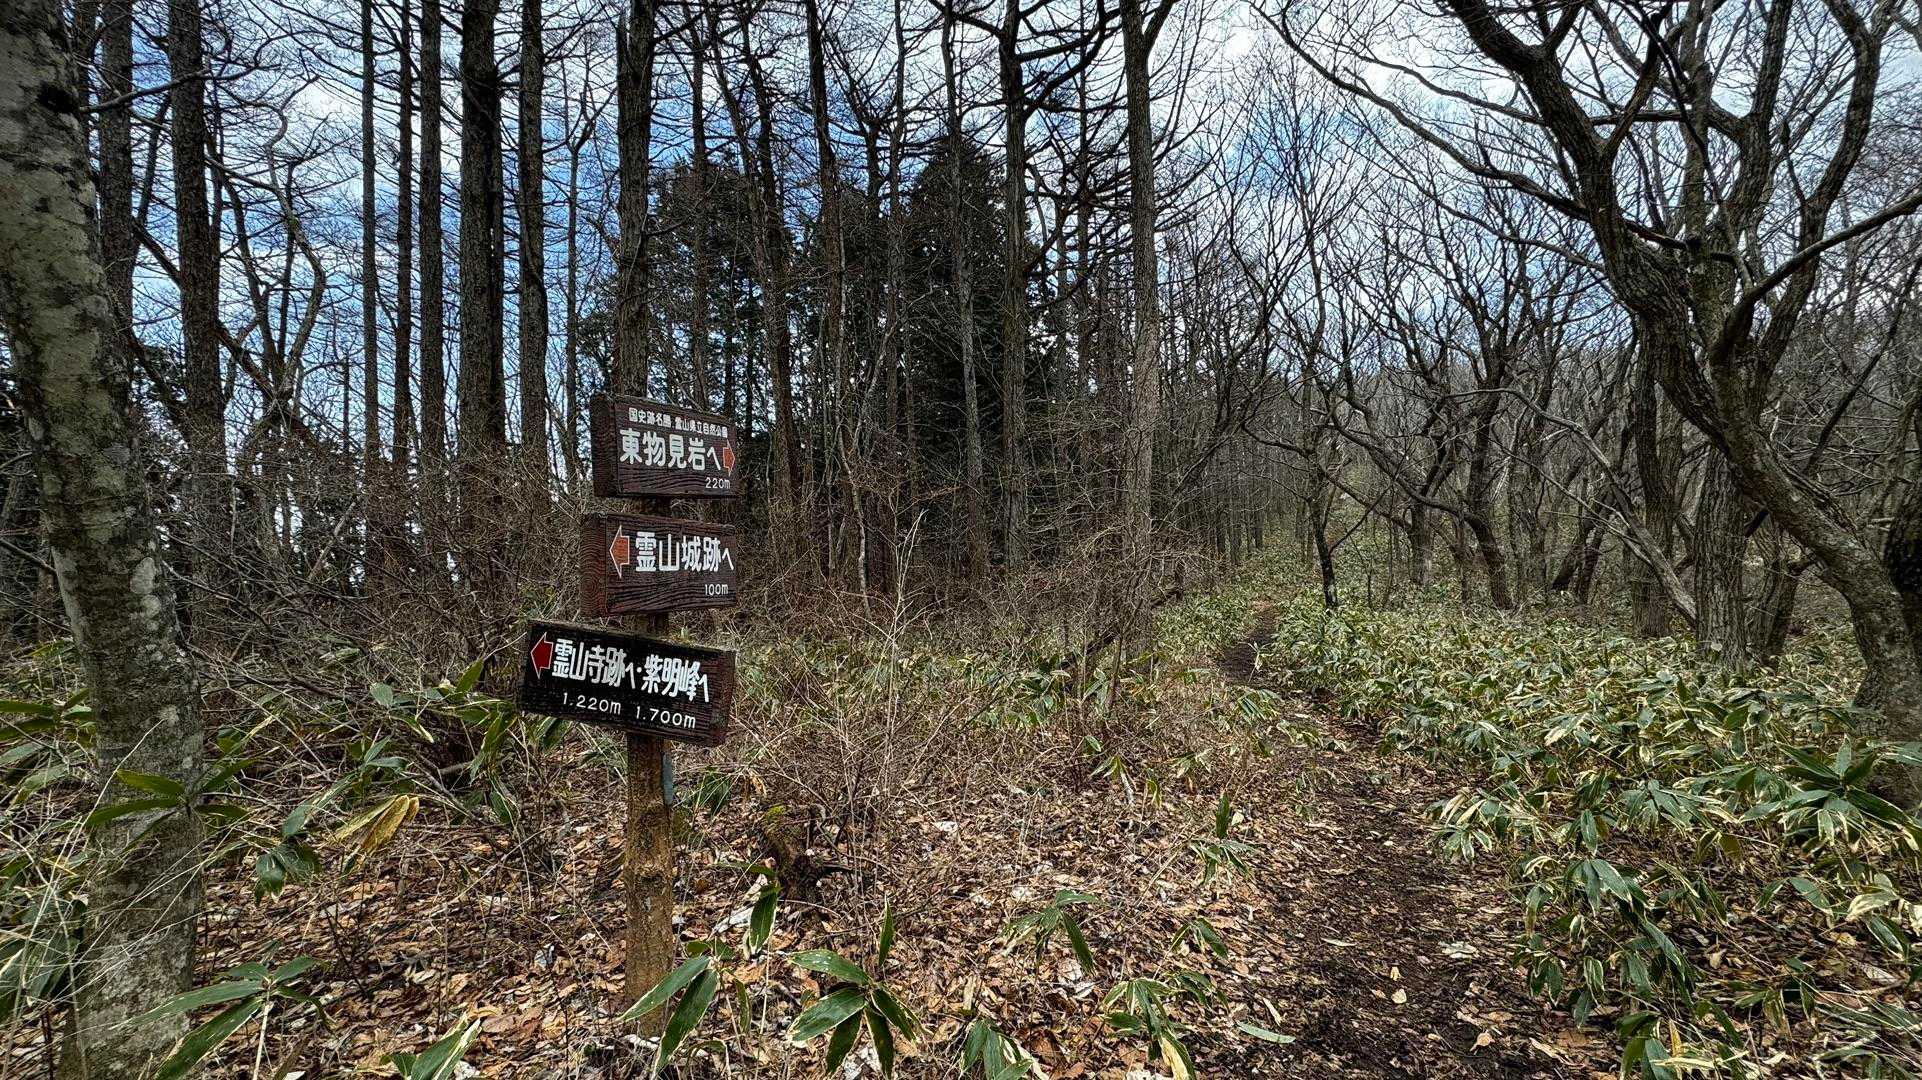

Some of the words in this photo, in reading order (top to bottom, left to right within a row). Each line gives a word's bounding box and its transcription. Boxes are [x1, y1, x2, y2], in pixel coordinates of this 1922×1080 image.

[619, 428, 721, 471] 東物見岩へ
[705, 477, 731, 489] 220m
[635, 531, 735, 572] 霊山城跡へ
[704, 583, 729, 596] 100m
[563, 692, 622, 715] 1.220m
[635, 706, 696, 728] 1.700m
